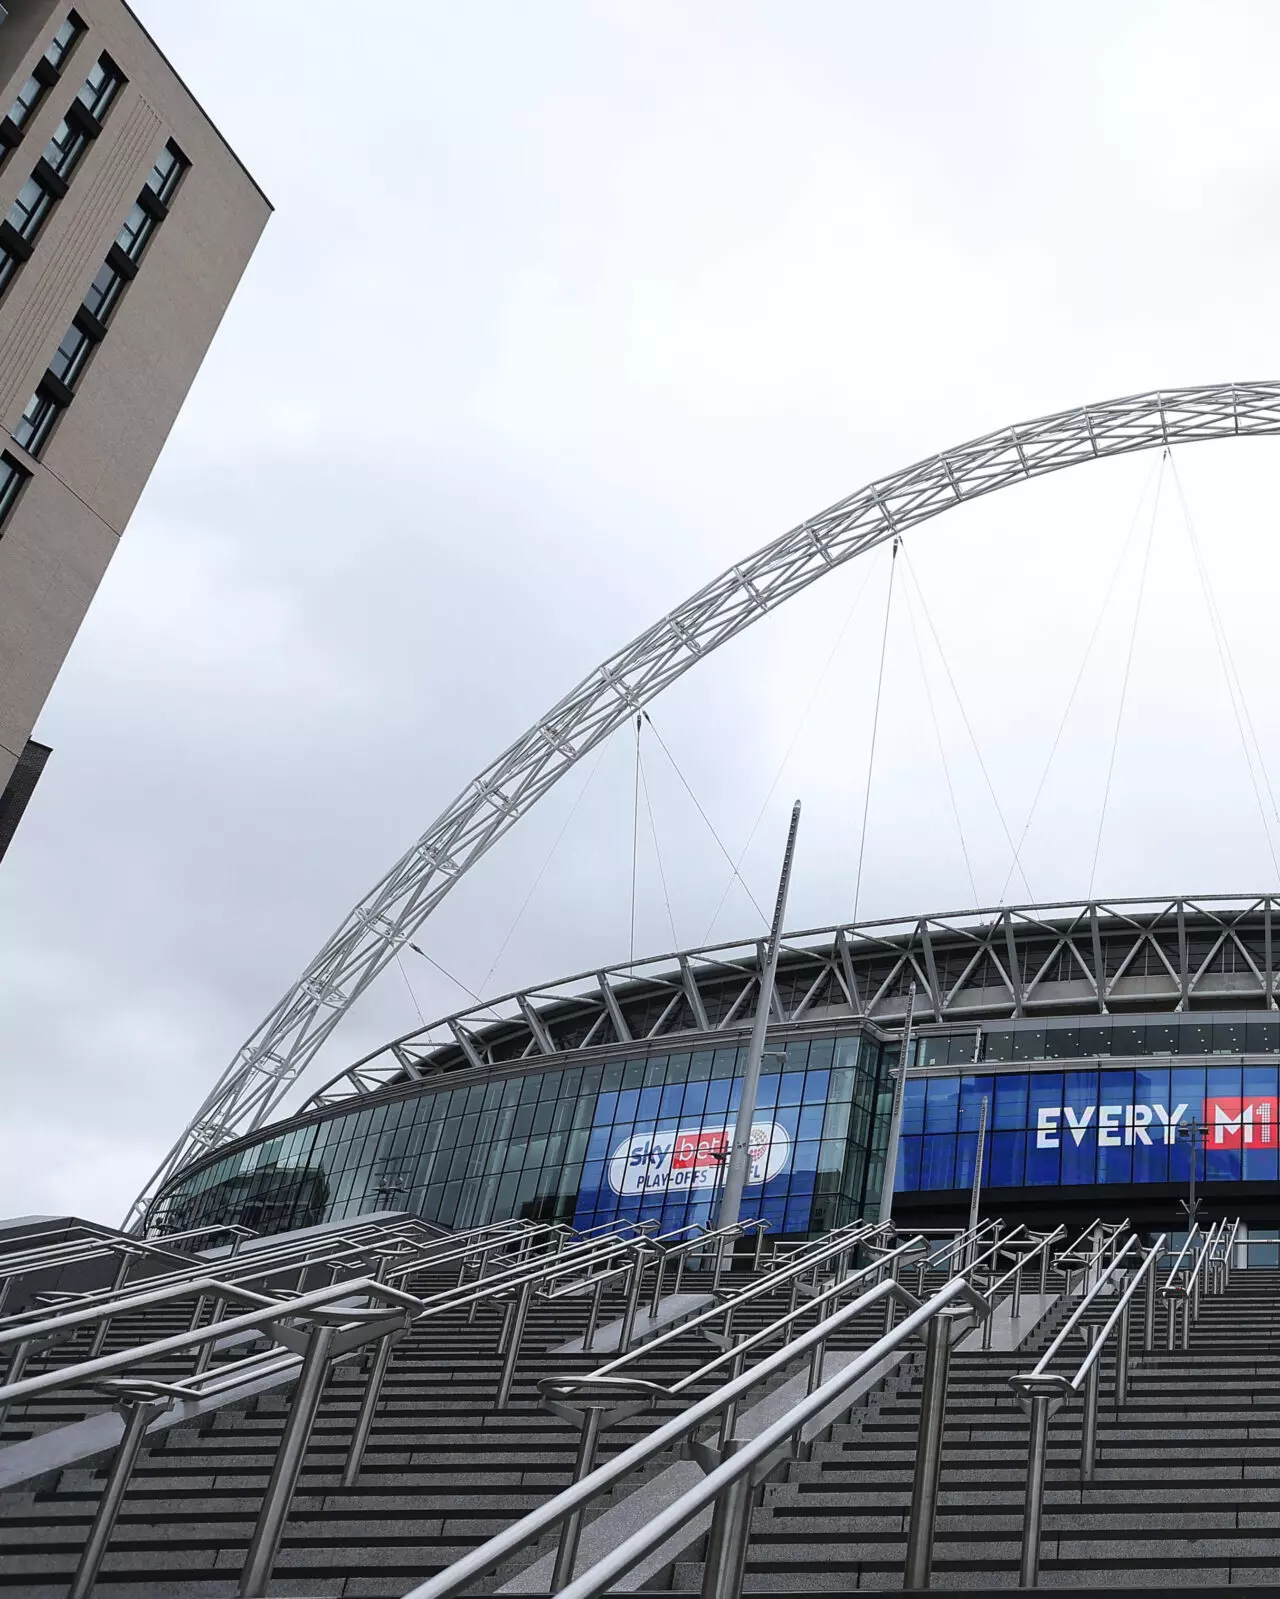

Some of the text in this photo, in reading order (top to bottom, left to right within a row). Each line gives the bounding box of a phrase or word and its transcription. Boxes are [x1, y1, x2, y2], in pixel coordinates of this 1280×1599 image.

[1036, 1103, 1188, 1149] EVERY
[630, 1137, 721, 1169] sky bet
[637, 1169, 708, 1188] PLAY-OFFS
